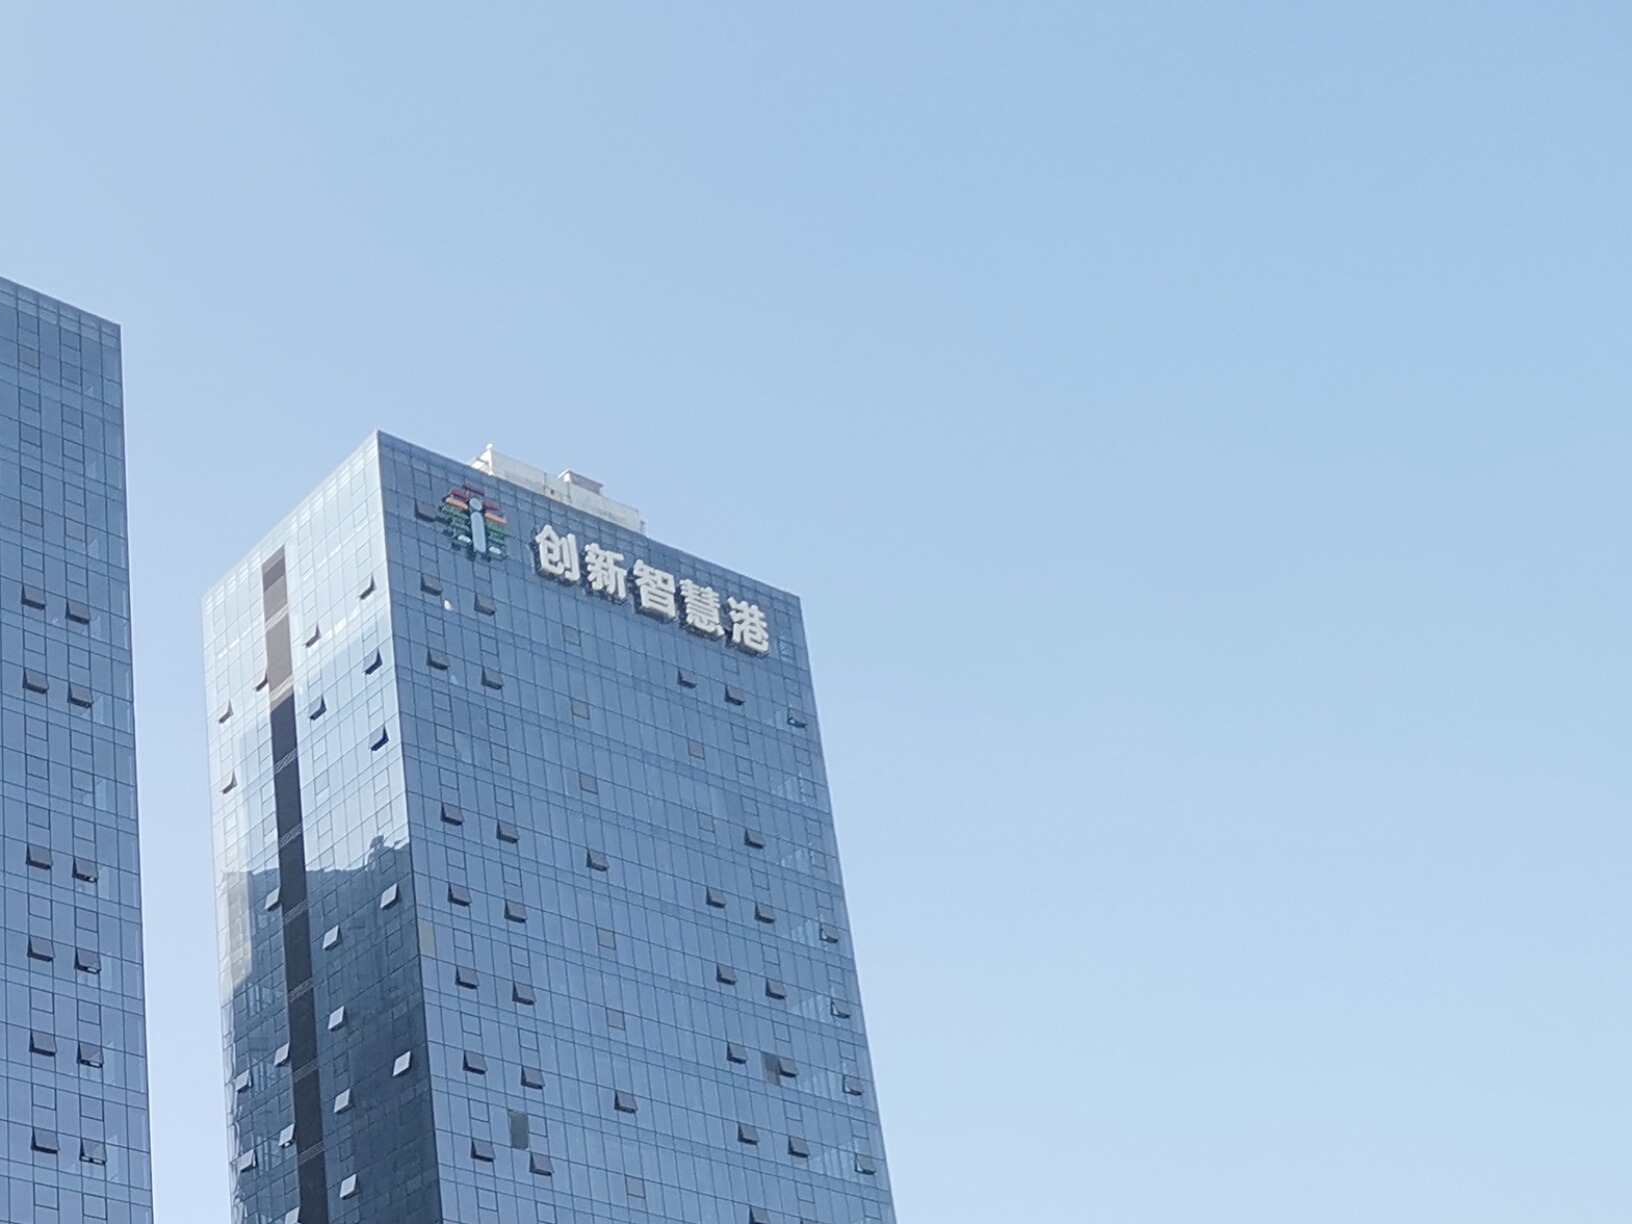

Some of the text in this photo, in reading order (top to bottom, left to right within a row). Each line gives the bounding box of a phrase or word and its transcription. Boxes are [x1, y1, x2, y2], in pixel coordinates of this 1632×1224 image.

[534, 523, 770, 656] 创新智慧港
